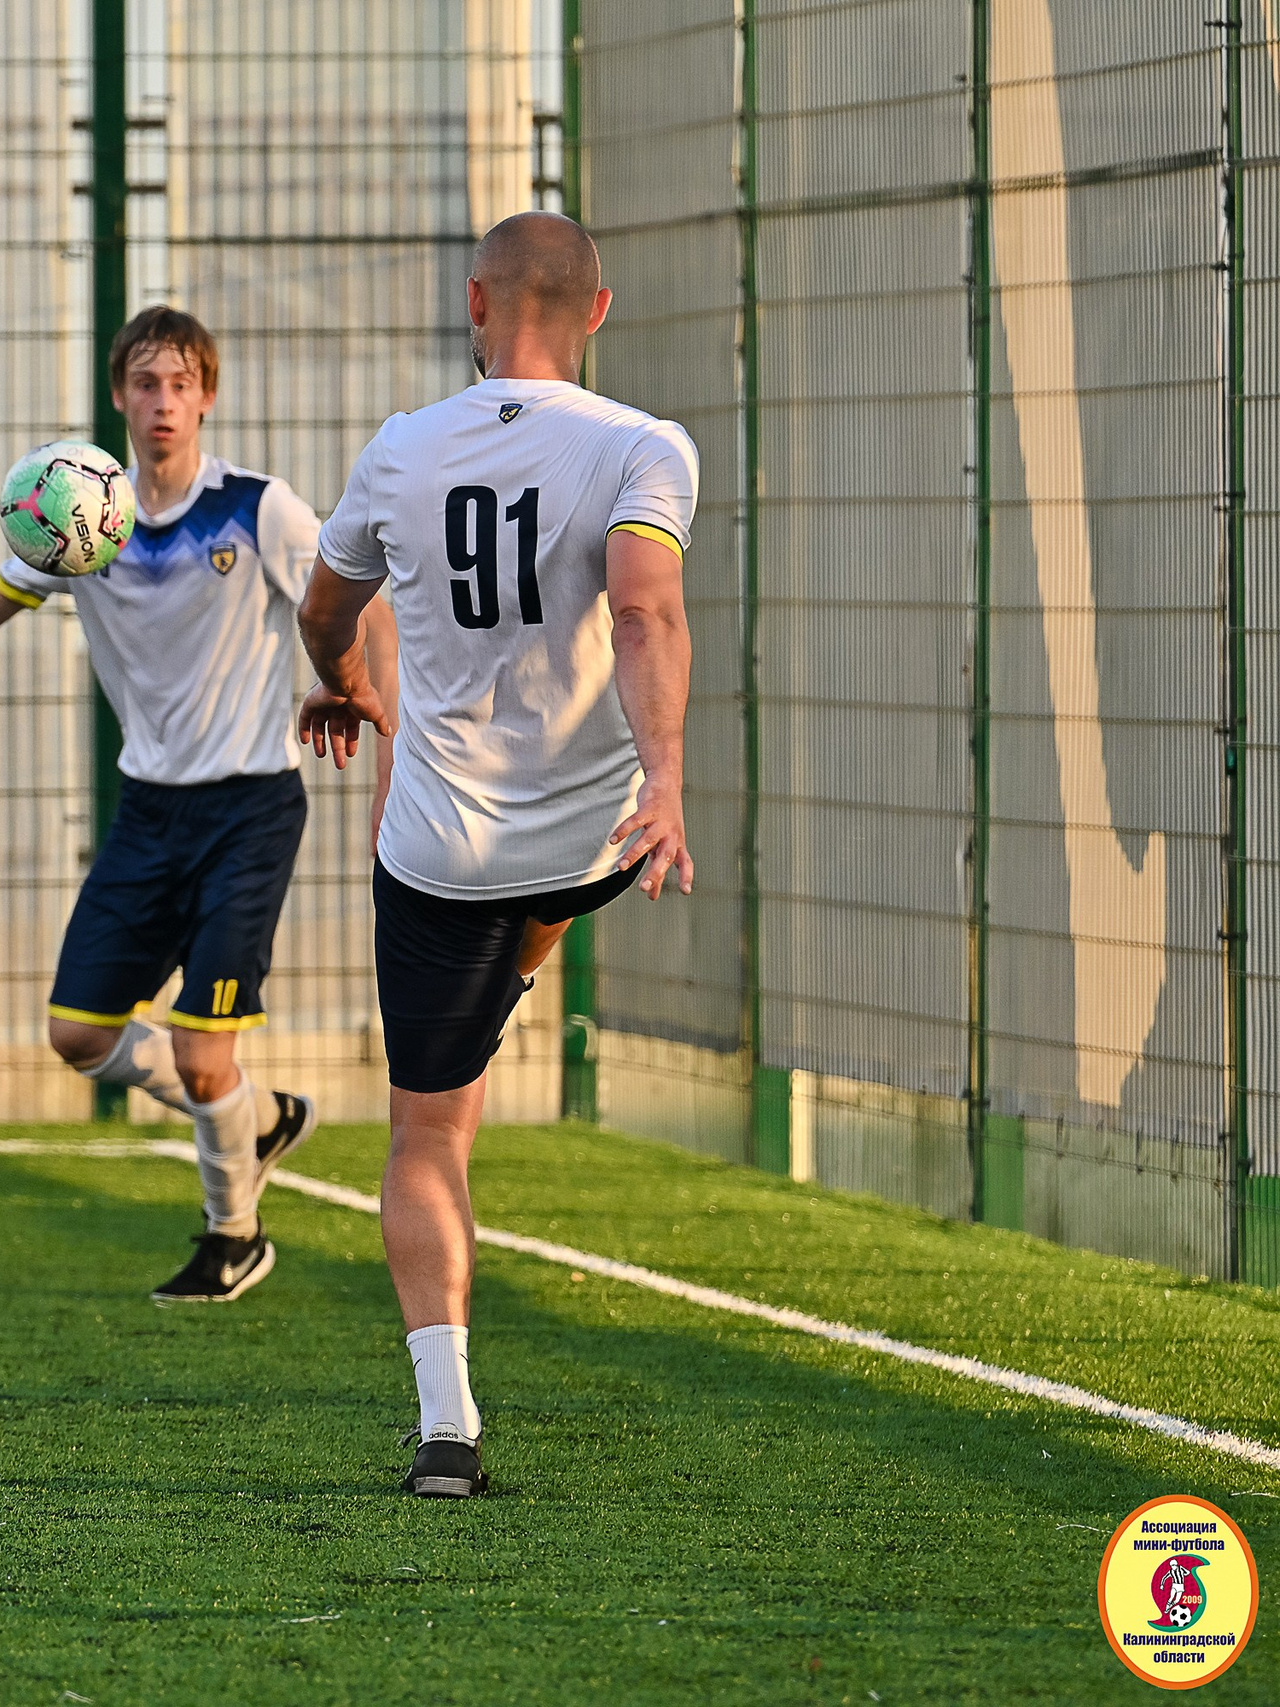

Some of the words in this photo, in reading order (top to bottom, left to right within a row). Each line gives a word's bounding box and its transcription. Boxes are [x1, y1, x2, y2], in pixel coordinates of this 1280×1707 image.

[72, 504, 96, 563] VISION
[445, 485, 544, 629] 91
[212, 979, 238, 1015] 10
[428, 1432, 459, 1440] adidas
